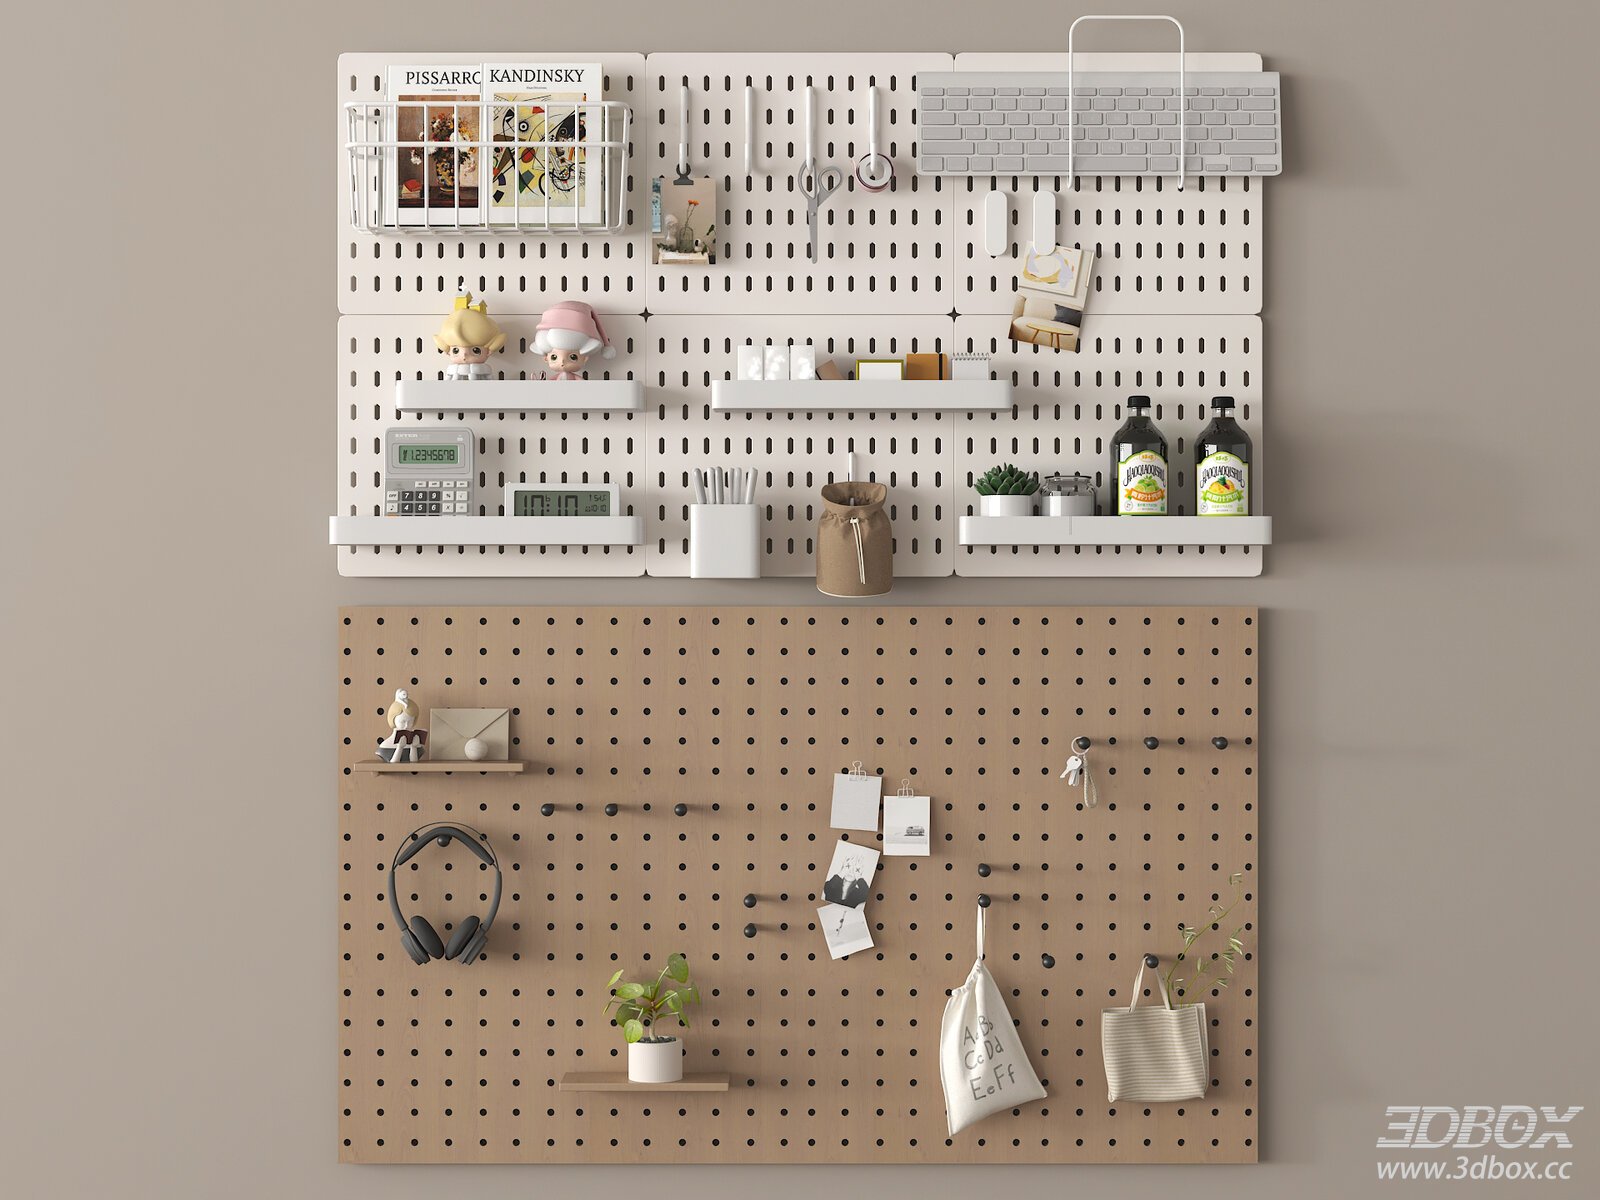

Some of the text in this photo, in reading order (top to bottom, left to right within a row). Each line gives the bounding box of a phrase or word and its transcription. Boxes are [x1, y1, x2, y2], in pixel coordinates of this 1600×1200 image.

[489, 69, 585, 83] KANDINSKY
[983, 1035, 1004, 1060] Dd
[969, 1063, 1015, 1101] Ee Ff
